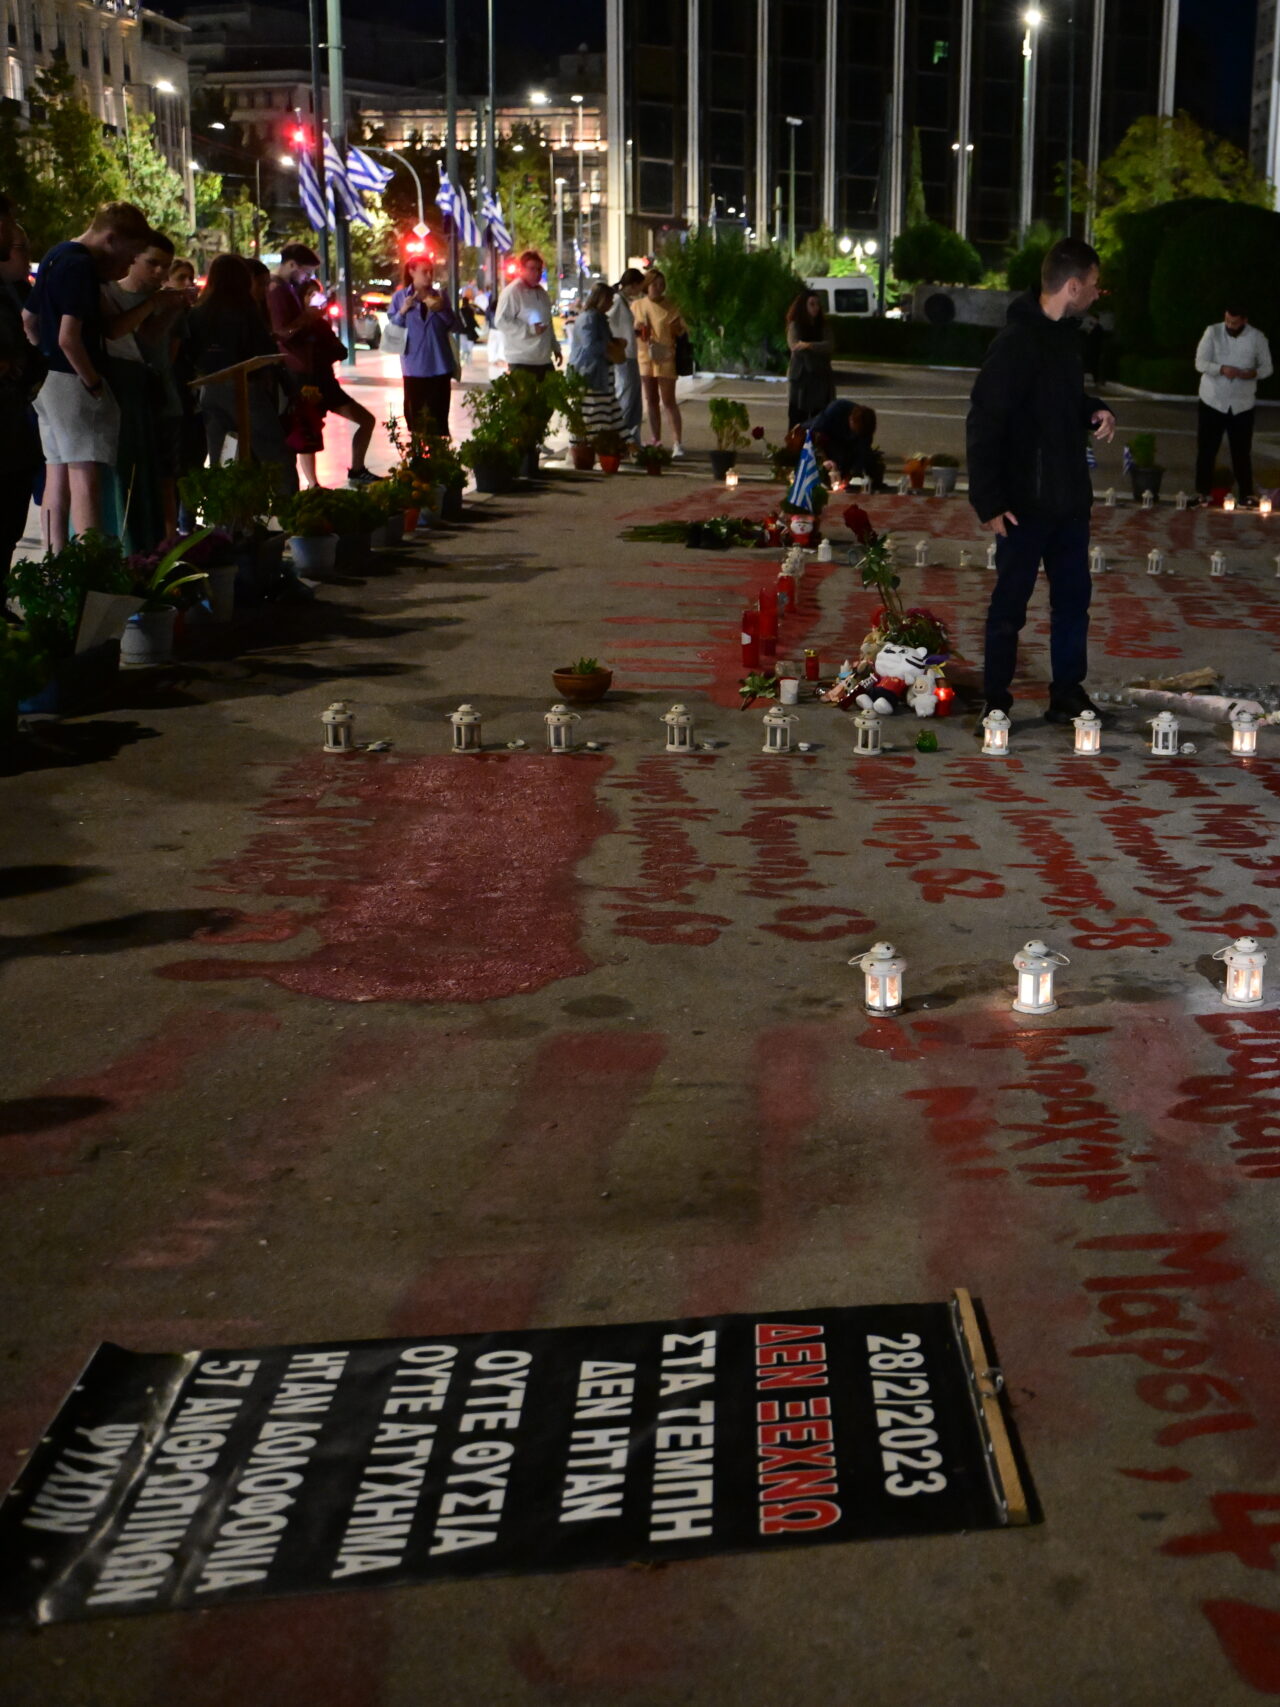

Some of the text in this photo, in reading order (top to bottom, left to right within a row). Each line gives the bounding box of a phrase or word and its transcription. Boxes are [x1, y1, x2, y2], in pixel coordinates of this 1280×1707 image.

[759, 905, 877, 941] 63
[908, 868, 1005, 903] 62
[1070, 917, 1173, 951] 58
[1177, 904, 1278, 939] 57
[21, 1424, 139, 1533] ΨΥΧΩΝ
[87, 1359, 261, 1605] 57 ΑΝΘΡΩΠΙΝΩΝ
[194, 1351, 350, 1594] ΗΤΑΝ ΔΟΛΟΦΟΝΙΑ
[332, 1344, 459, 1579] ΟΥΤΕ ΑΤΥΧΗΜΑ
[429, 1350, 533, 1556] ΟΥΤΕ ΘΥΣΙΑ
[559, 1361, 637, 1523] ΔΕΝ ΗΤΑΝ
[648, 1330, 718, 1542] ΣΤΑ ΤΕΜΠΗ
[755, 1322, 842, 1536] ΔΕΝ ΞΕΧΝΩ
[866, 1332, 947, 1498] 28/2/2023
